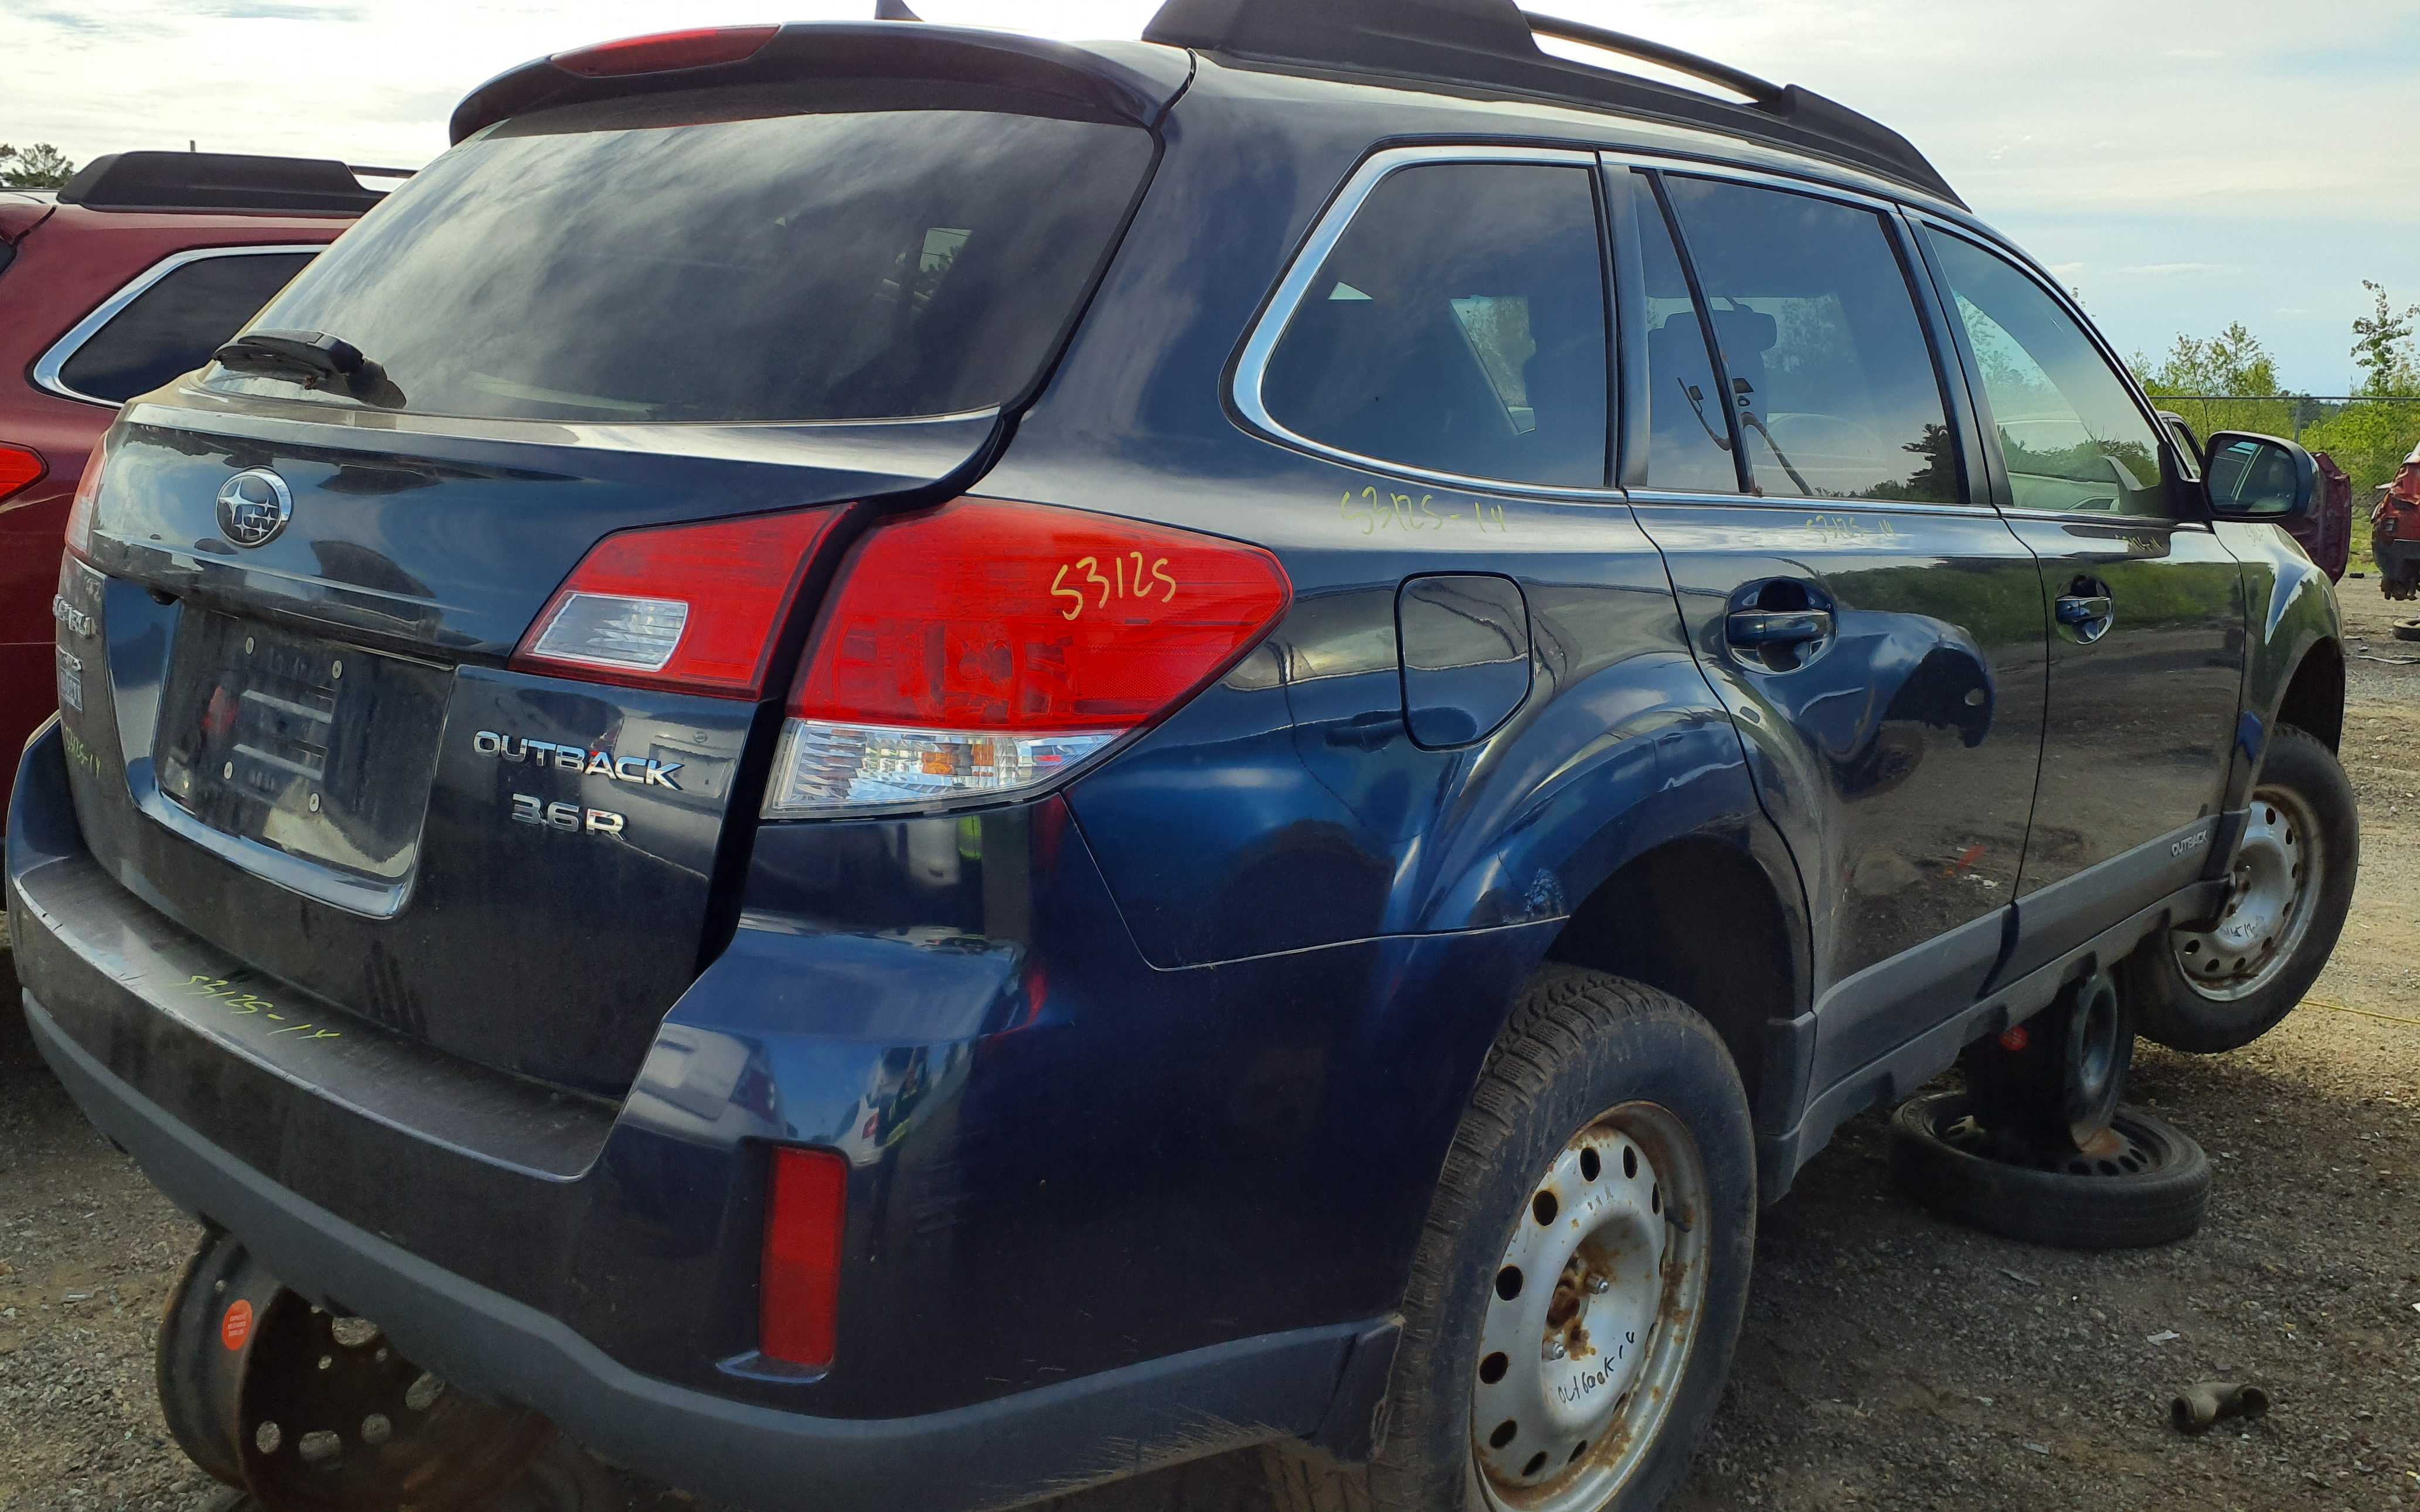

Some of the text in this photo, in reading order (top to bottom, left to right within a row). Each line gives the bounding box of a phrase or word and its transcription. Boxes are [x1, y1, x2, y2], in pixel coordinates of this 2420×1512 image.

[1051, 551, 1176, 621] 53125
[473, 730, 685, 791] OUTBACK
[511, 793, 627, 841] 3.6R
[2171, 830, 2208, 857] OUTBACK
